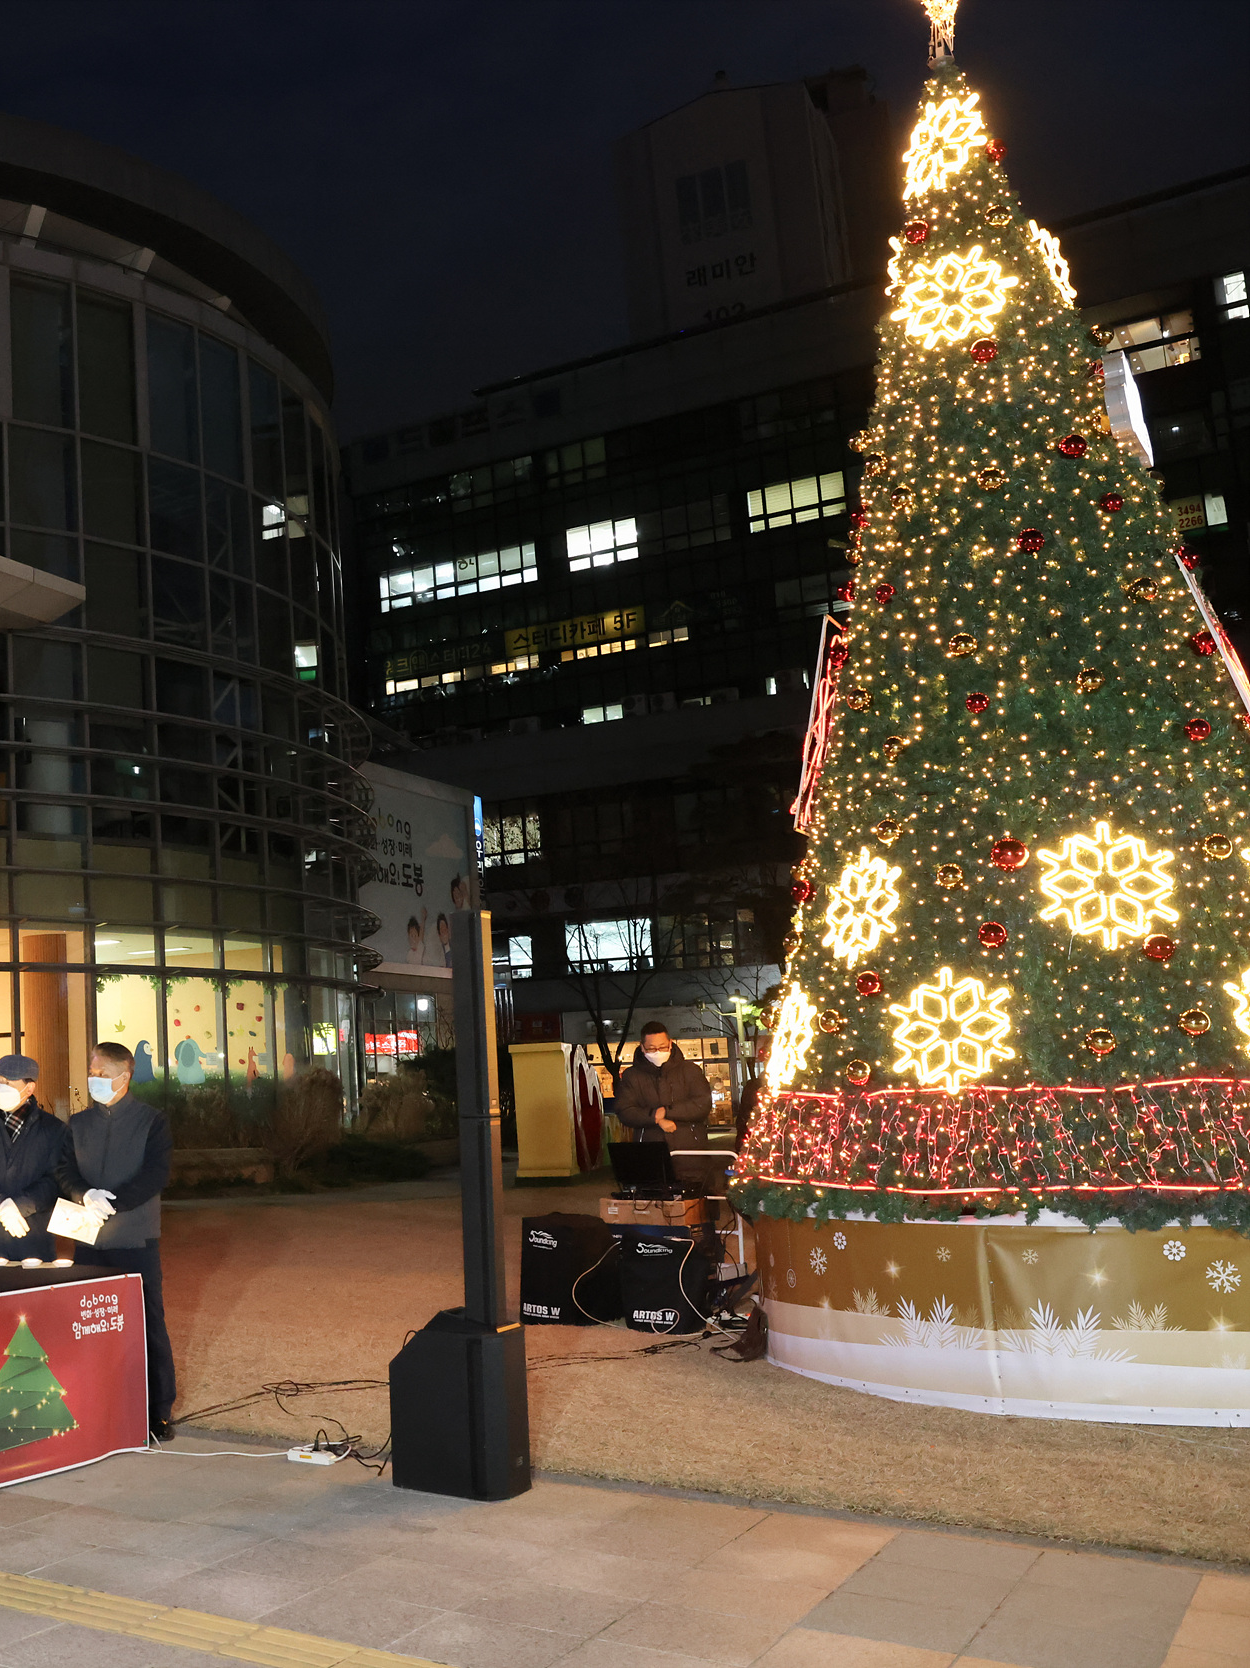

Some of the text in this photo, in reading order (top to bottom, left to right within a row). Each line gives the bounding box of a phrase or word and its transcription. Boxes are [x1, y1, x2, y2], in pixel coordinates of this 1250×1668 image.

[686, 252, 756, 286] 래미안
[1177, 503, 1201, 516] 3494
[513, 617, 607, 650] 스터디카페
[613, 612, 637, 631] 5F
[401, 863, 425, 897] 도봉
[80, 1294, 118, 1308] dobong
[523, 1302, 549, 1315] ARTOS
[550, 1306, 561, 1316] W
[109, 1313, 125, 1332] 도봉
[632, 1309, 675, 1321] ARTOS W
